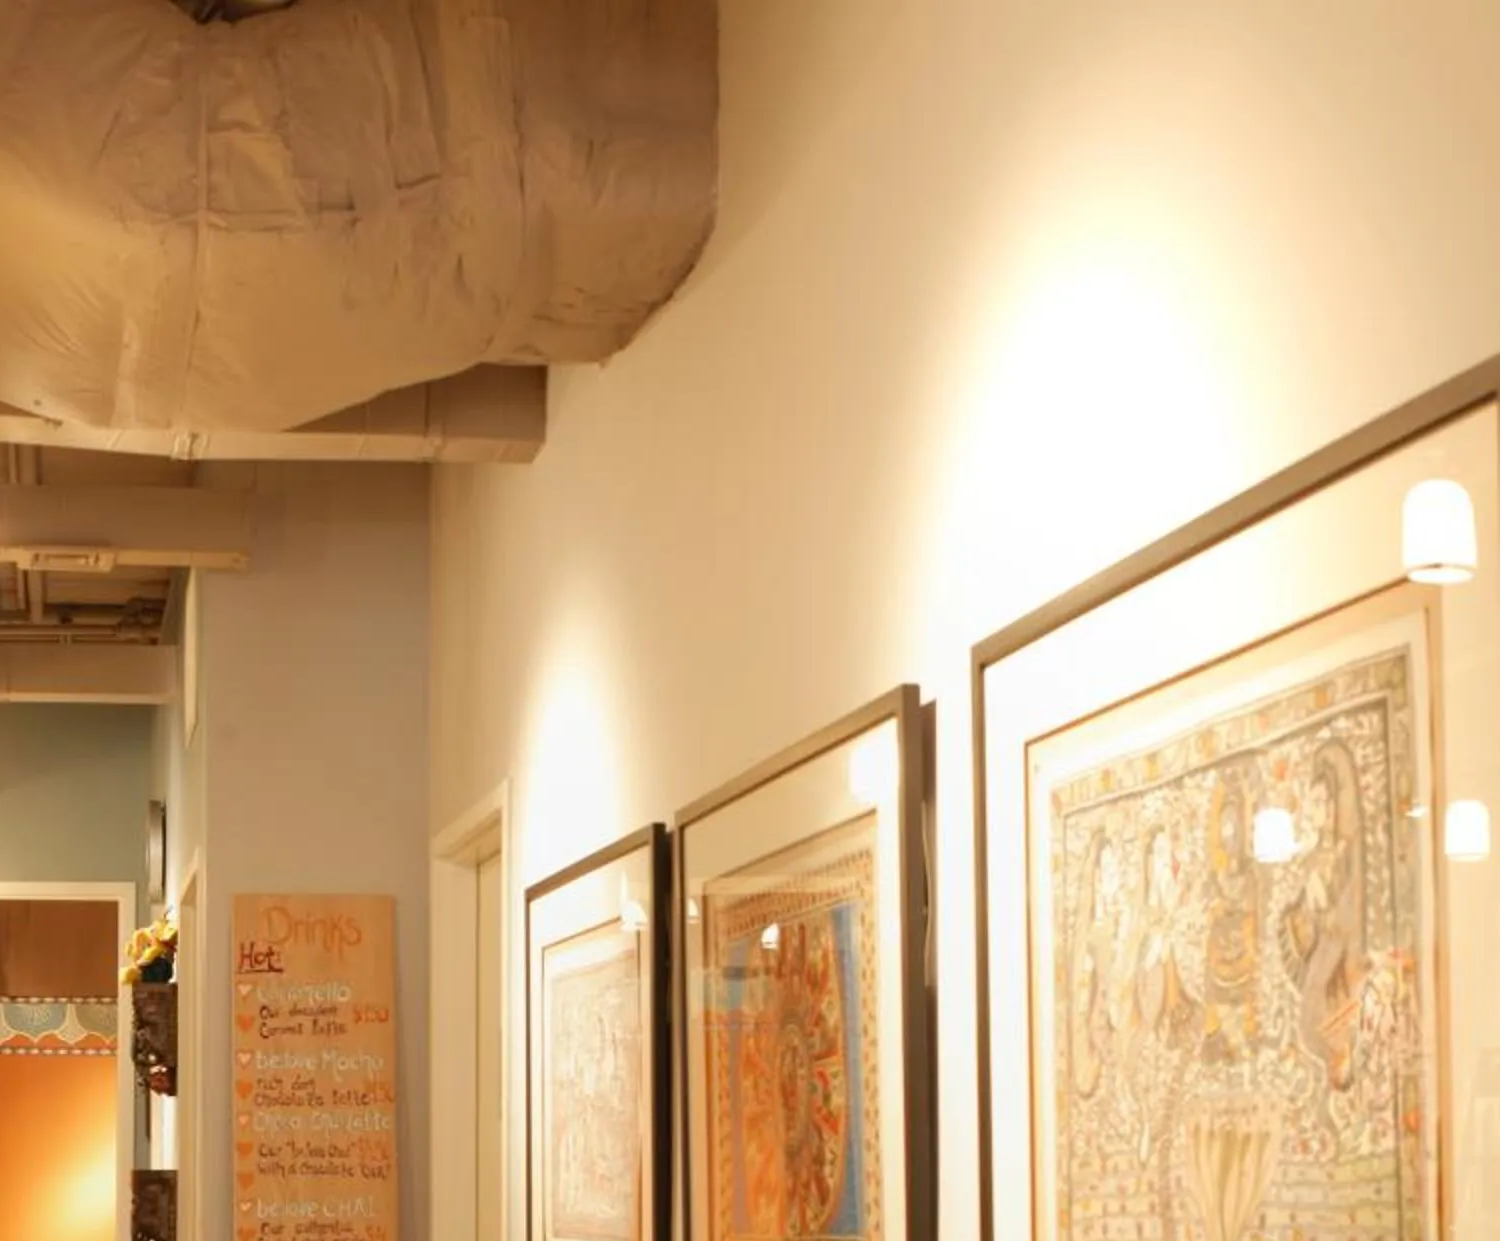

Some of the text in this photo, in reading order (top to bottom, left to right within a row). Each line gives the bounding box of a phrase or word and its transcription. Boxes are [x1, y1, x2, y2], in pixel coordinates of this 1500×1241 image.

[265, 904, 362, 958] Drinks
[238, 942, 280, 970] Hot
[322, 1196, 376, 1218] CHAI
